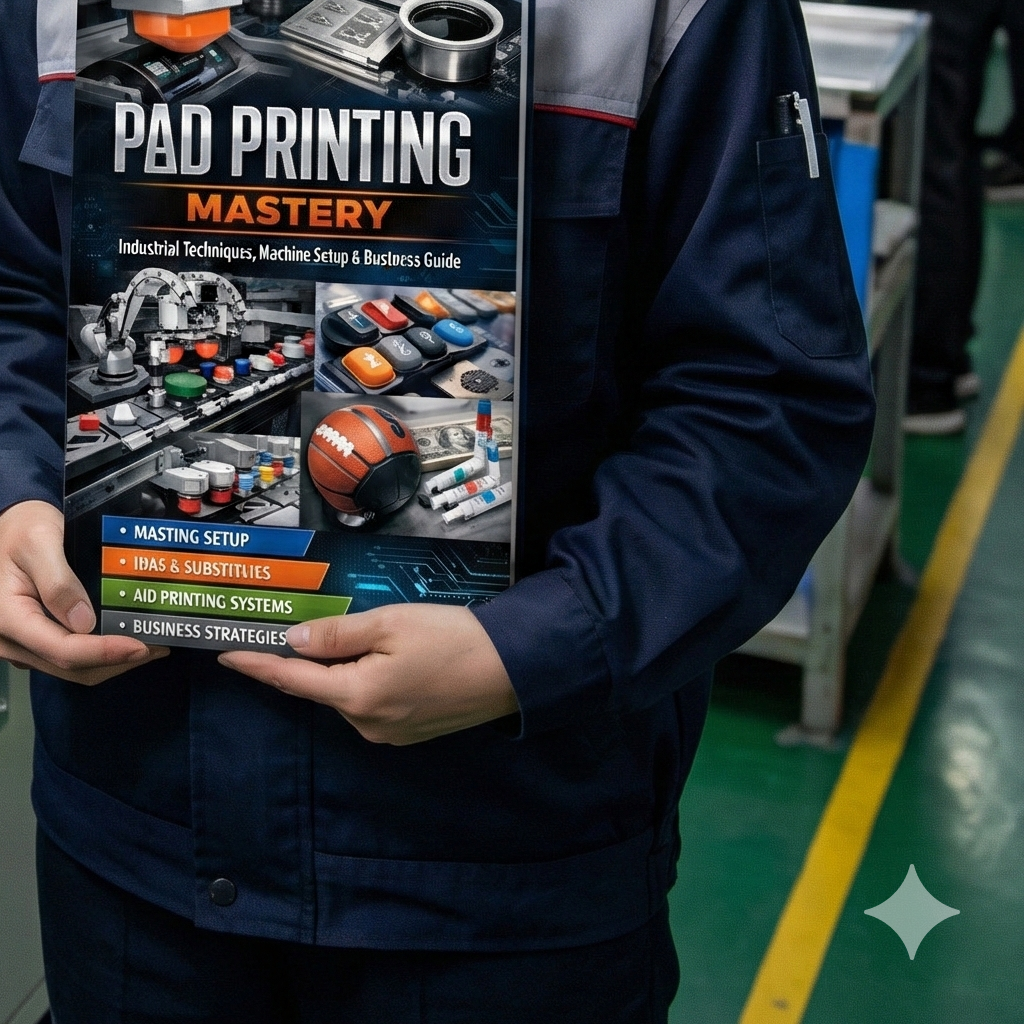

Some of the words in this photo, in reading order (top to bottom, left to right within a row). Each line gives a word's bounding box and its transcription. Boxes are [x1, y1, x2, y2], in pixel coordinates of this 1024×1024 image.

[113, 102, 212, 176] PAD
[230, 105, 472, 187] PRINTING
[186, 192, 393, 230] MASTERY
[118, 238, 179, 257] Industrial
[259, 244, 311, 262] Machine
[313, 247, 349, 268] Setup
[352, 250, 361, 265] &
[424, 251, 462, 270] Guide
[133, 524, 200, 545] MASTING
[203, 530, 250, 548] SETUP
[170, 558, 180, 574] &
[133, 588, 157, 604] AID
[160, 590, 226, 610] PRINTING
[230, 595, 293, 615] SYSTEMS
[133, 619, 201, 639] BUSINESS
[204, 625, 286, 646] STRATEGIES
